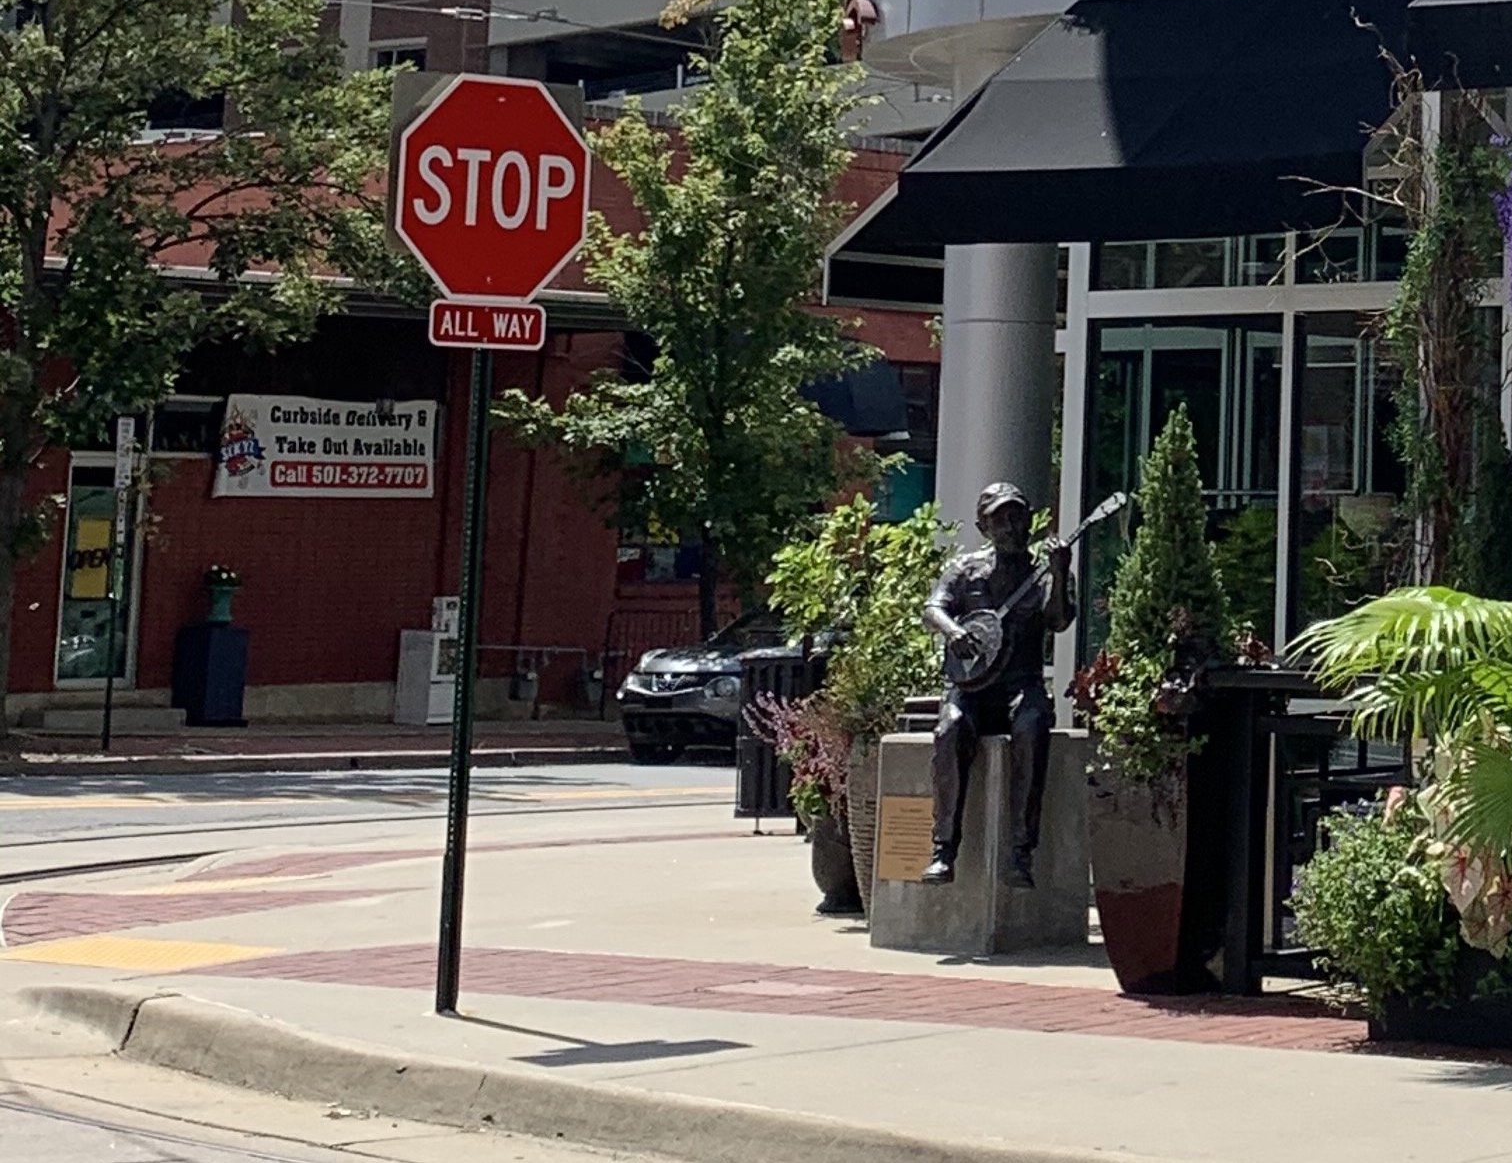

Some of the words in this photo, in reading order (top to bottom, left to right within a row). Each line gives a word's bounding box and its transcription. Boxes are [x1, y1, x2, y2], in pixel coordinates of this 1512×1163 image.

[413, 144, 576, 231] STOP
[440, 310, 479, 337] ALL
[492, 312, 535, 339] WAY
[270, 405, 340, 426] Curbside
[345, 410, 413, 431] Delivery
[417, 410, 427, 427] &
[275, 436, 316, 455] Take
[322, 437, 349, 456] Out
[353, 438, 426, 457] Available
[274, 465, 308, 484] Call
[312, 465, 425, 485] 501-372-7707
